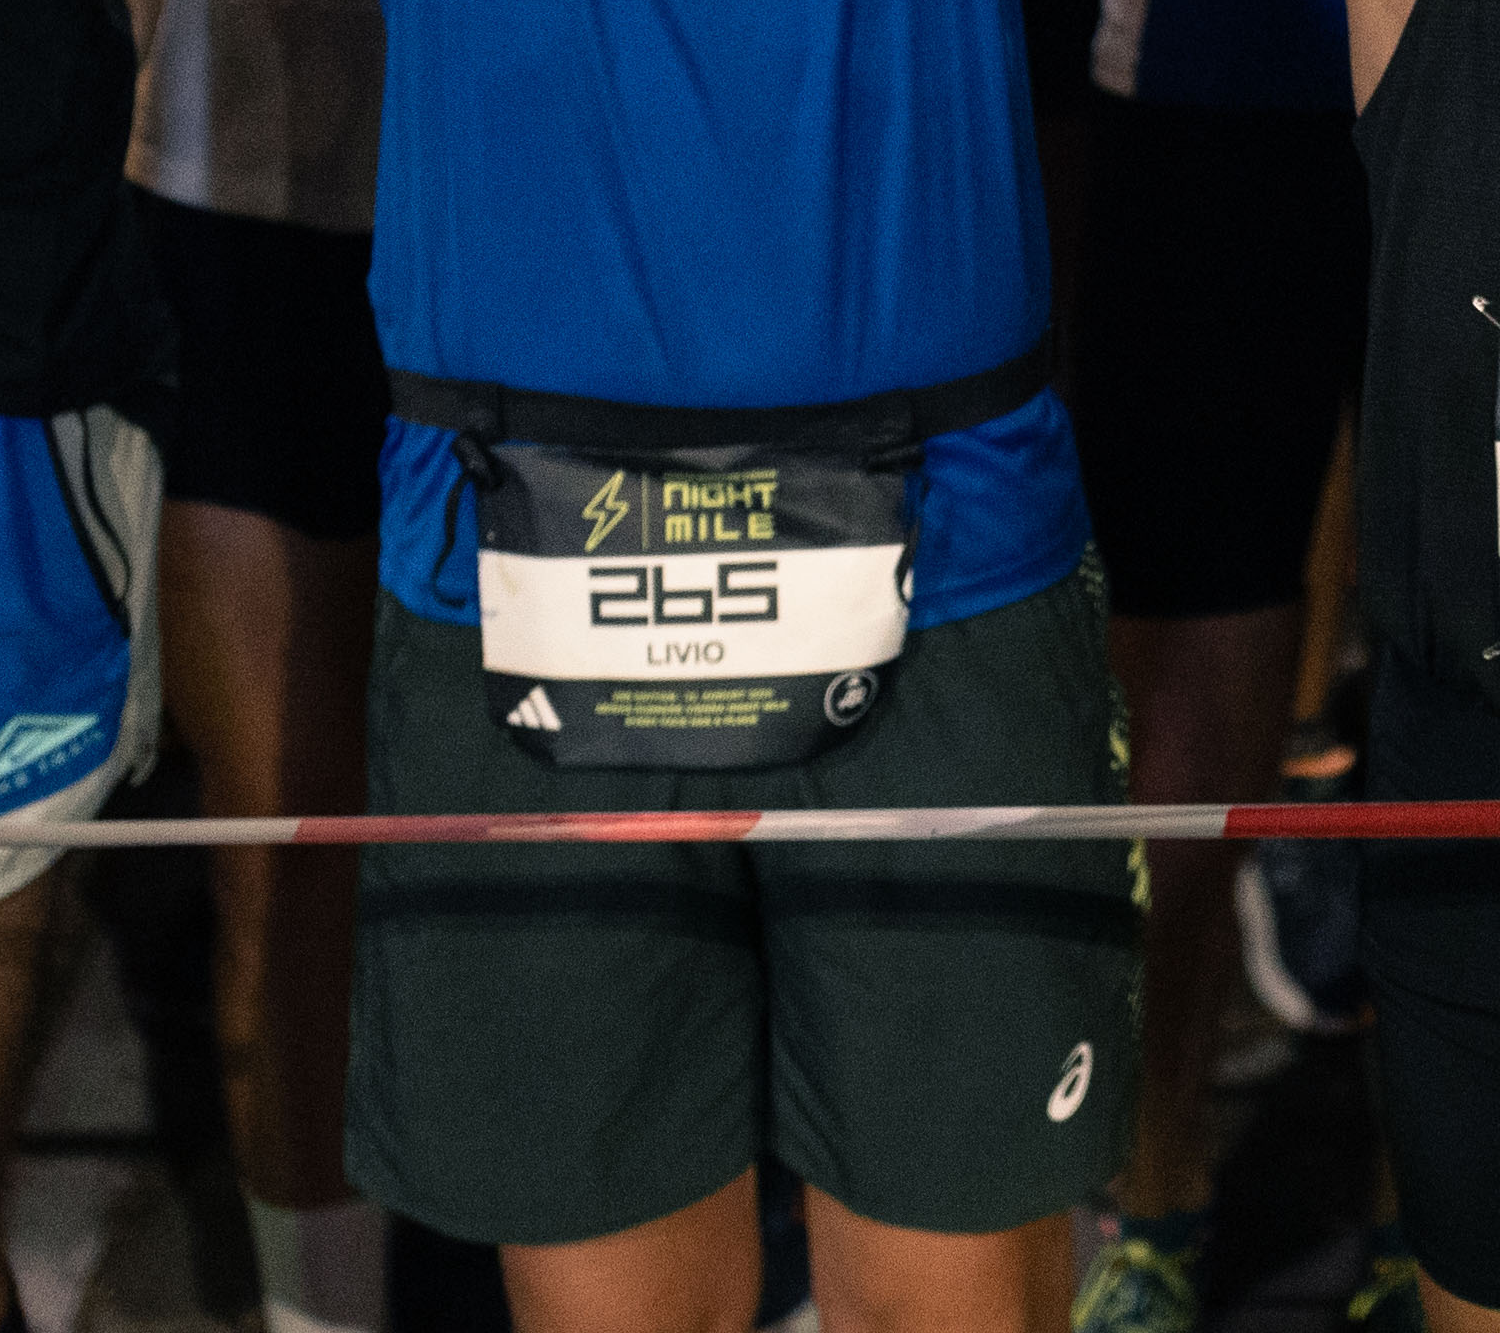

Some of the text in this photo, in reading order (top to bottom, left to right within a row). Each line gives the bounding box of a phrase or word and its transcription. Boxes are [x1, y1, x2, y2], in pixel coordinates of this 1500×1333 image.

[663, 481, 777, 510] NIGHT
[664, 512, 775, 542] MILE
[589, 561, 778, 626] 265
[647, 640, 725, 665] LIVIO
